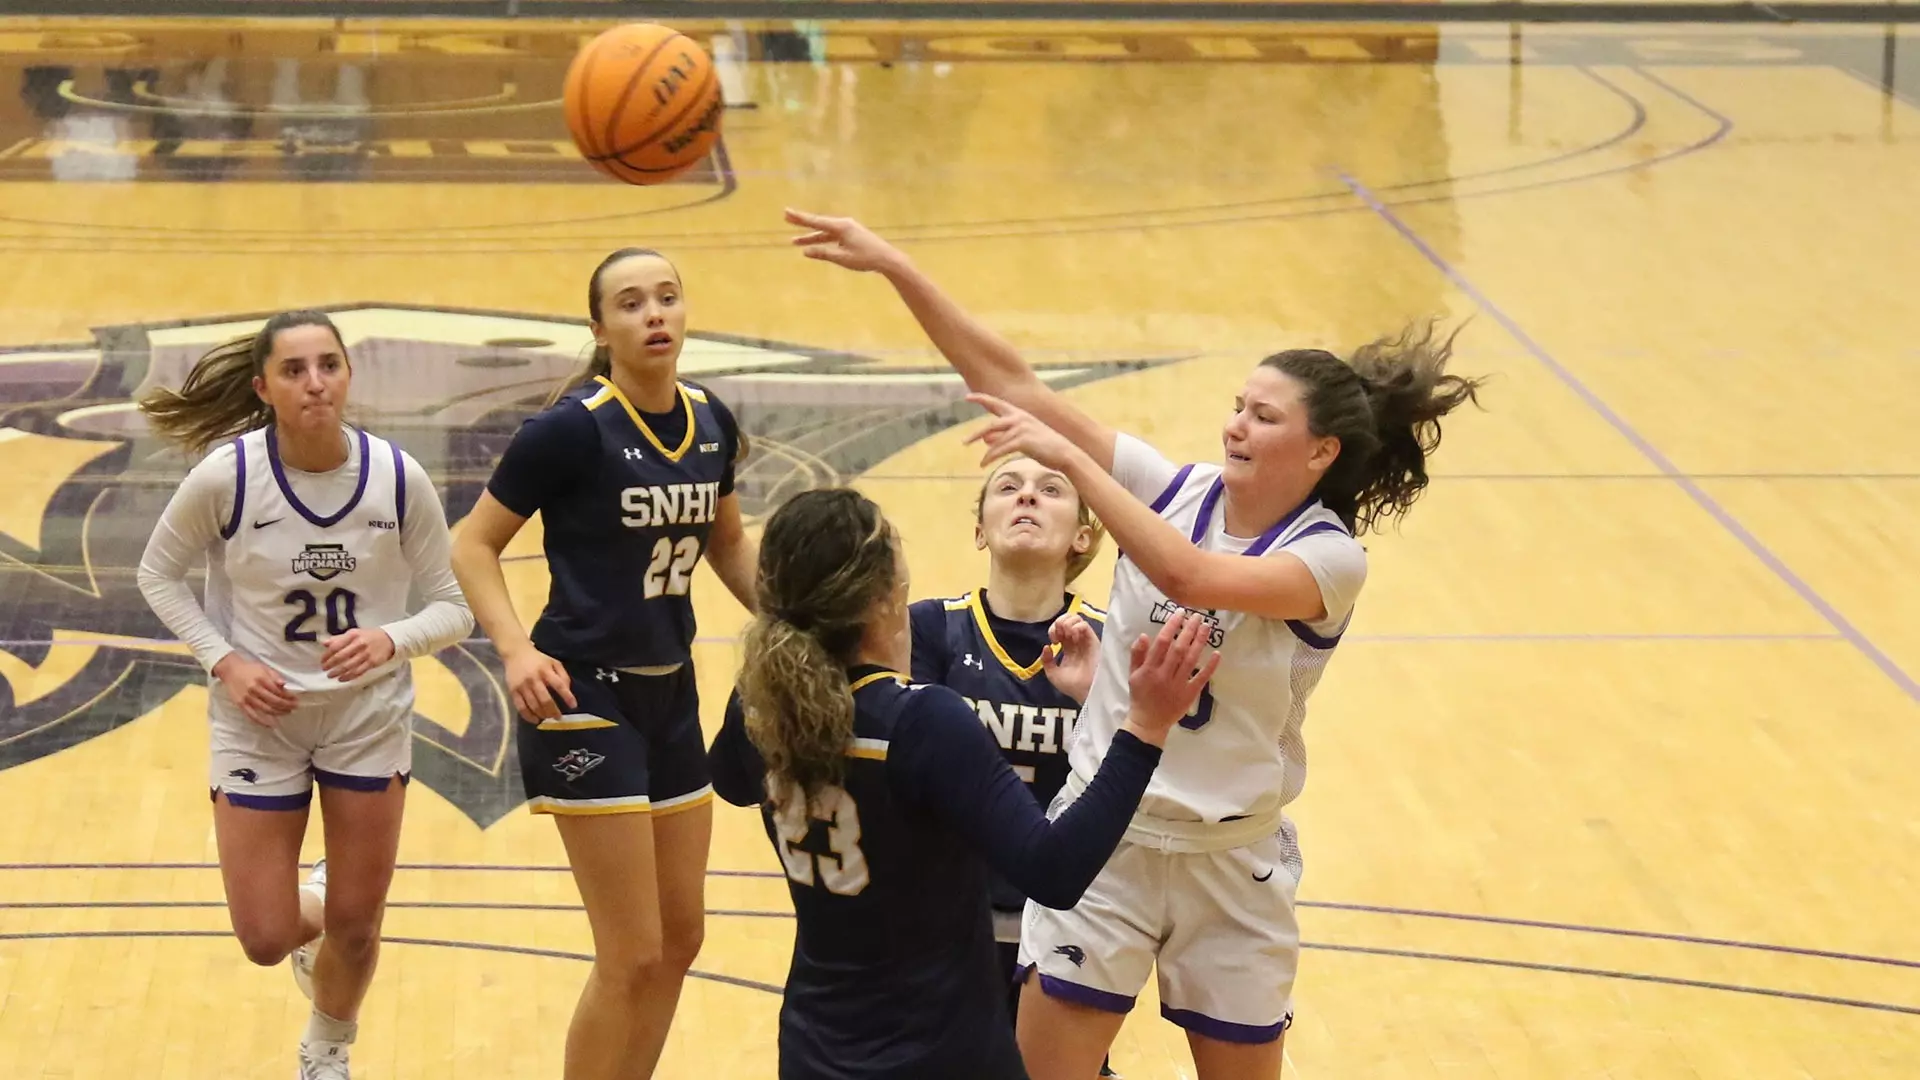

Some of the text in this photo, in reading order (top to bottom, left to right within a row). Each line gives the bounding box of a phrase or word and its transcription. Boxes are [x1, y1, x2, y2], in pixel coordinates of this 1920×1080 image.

[299, 551, 348, 560] SAINT
[643, 535, 700, 600] 22
[284, 587, 359, 642] 20
[766, 770, 871, 897] 23
